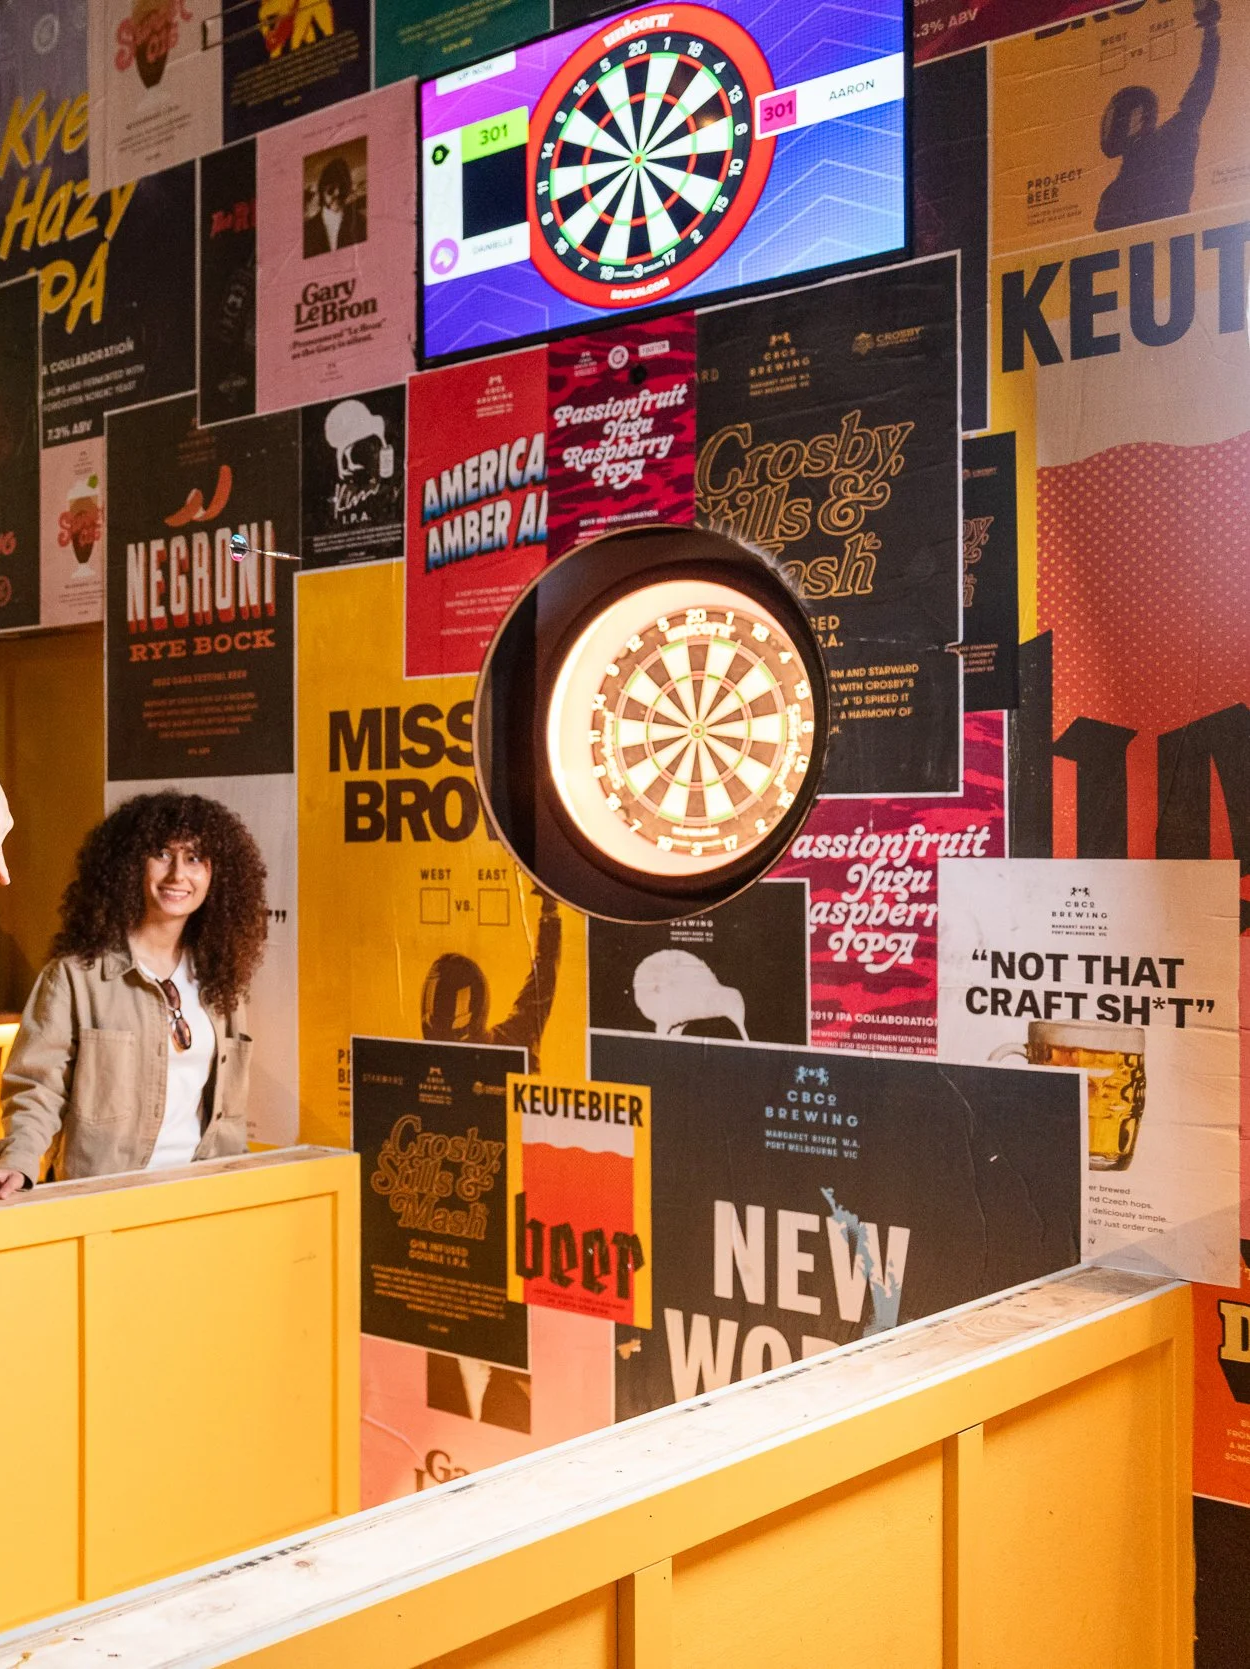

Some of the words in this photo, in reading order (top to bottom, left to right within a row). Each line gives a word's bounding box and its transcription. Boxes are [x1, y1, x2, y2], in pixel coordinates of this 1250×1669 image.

[948, 8, 980, 30] ABV
[602, 13, 674, 48] unicorn
[627, 39, 648, 57] 20
[663, 36, 672, 51] 1
[687, 40, 704, 58] 18
[599, 57, 612, 73] 5
[712, 61, 727, 75] 4
[572, 79, 590, 97] 12
[763, 100, 794, 122] 301
[828, 79, 876, 102] AARON
[478, 123, 509, 146] 301
[728, 158, 744, 177] 10
[1027, 168, 1083, 191] PROJECT
[711, 194, 730, 213] 15
[1027, 187, 1060, 204] BEER
[689, 229, 704, 245] 2
[577, 257, 590, 271] 7
[661, 248, 677, 266] 17
[30, 241, 110, 336] PA
[301, 277, 357, 306] Gary
[293, 297, 378, 328] LeBron
[876, 325, 922, 343] CROSBY
[750, 356, 812, 378] BREWING
[553, 383, 688, 428] Passionfruit
[562, 434, 675, 472] Raspberry
[591, 457, 646, 490] IPA
[817, 470, 891, 536] &
[427, 499, 513, 572] AMBER
[762, 533, 879, 601] ash
[126, 520, 276, 634] NEGRONI
[726, 611, 735, 625] 1
[129, 639, 187, 662] RYE
[193, 628, 276, 656] BOCK
[846, 666, 867, 679] AND
[867, 663, 920, 677] STARWARD
[839, 680, 864, 692] WITH
[864, 677, 915, 692] CROSBY'S
[865, 693, 899, 706] SPIKED
[900, 692, 910, 703] IT
[839, 711, 847, 720] A
[848, 707, 897, 720] HARMONY
[899, 706, 913, 718] OF
[328, 701, 475, 773] MISS
[344, 776, 498, 843] BRO
[629, 818, 643, 833] 7
[791, 824, 991, 868] assionfruit
[420, 868, 452, 881] WEST
[478, 868, 508, 881] EAST
[455, 900, 475, 913] VS.
[1051, 911, 1108, 919] BREWING
[828, 930, 919, 974] IPA
[1077, 954, 1186, 990] THAT
[965, 985, 1089, 1021] CRAFT
[810, 1010, 835, 1021] 2019
[836, 1011, 853, 1022] IPA
[852, 1032, 868, 1041] AND
[869, 1033, 922, 1044] FERMENTATION
[856, 1043, 898, 1053] SWEETNESS
[513, 1083, 644, 1128] KEUTEBIER
[765, 1106, 859, 1128] BREWING
[765, 1129, 809, 1142] MARGARET
[811, 1134, 838, 1146] RIVER
[765, 1140, 786, 1150] PORT
[788, 1143, 838, 1158] MELBOURNE
[843, 1150, 858, 1160] VIC
[370, 1150, 454, 1199] Stills
[455, 1162, 495, 1202] &
[1099, 1184, 1131, 1196] brewed
[1102, 1196, 1129, 1207] Czech
[1130, 1199, 1154, 1210] hops.
[389, 1187, 488, 1241] Mash
[1092, 1207, 1137, 1220] deliciously
[1104, 1220, 1120, 1229] Just
[1122, 1223, 1145, 1232] order
[1147, 1226, 1167, 1235] one.
[515, 1191, 646, 1301] beer
[713, 1200, 911, 1327] NEW
